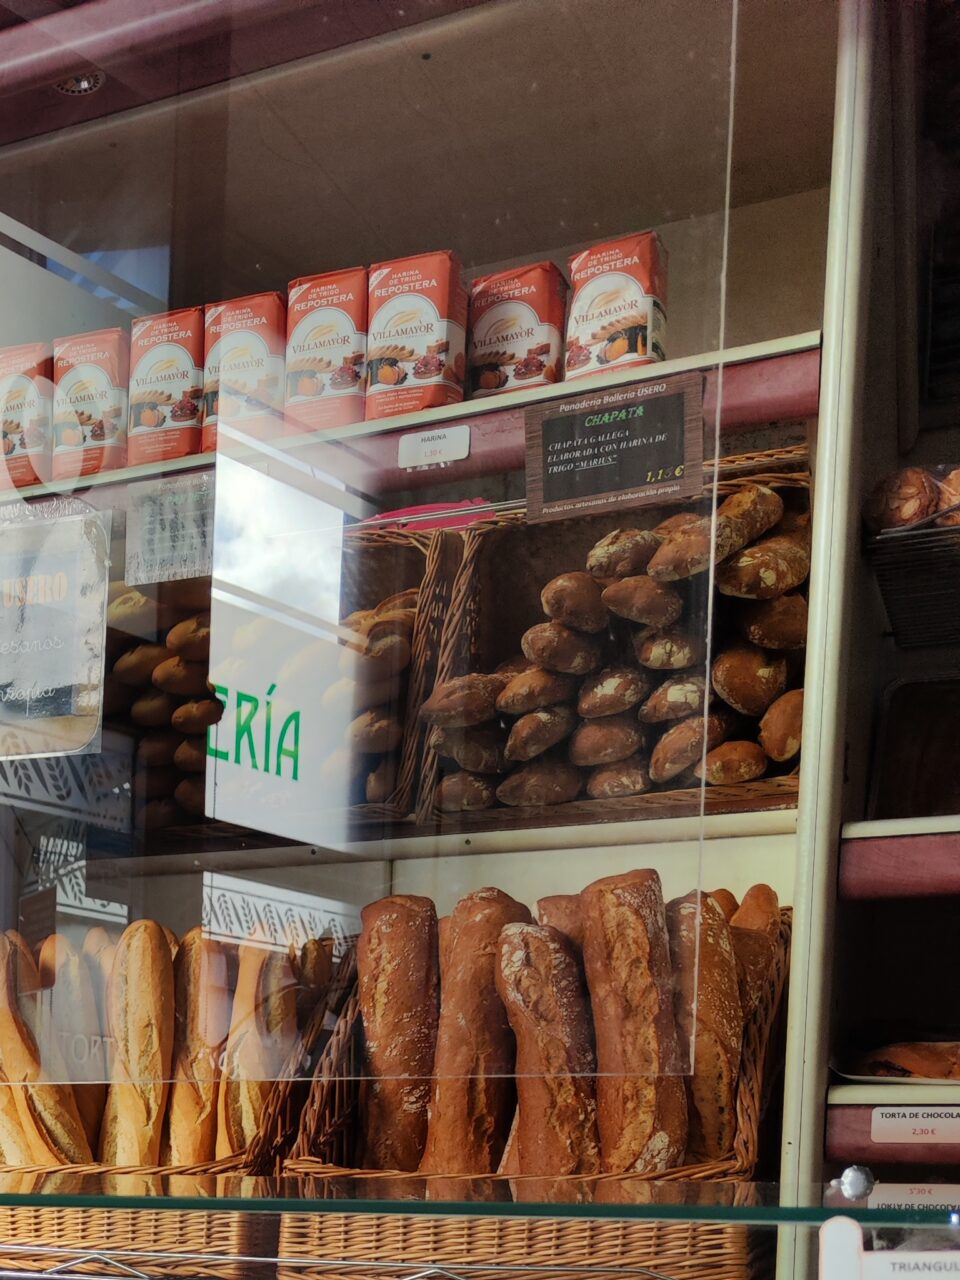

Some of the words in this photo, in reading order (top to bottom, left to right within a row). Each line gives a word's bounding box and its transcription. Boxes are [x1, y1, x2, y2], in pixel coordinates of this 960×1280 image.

[574, 256, 639, 281] REPOSTERA
[374, 279, 437, 298] REPOSTERA
[475, 285, 536, 308] REPOSTERA
[294, 292, 354, 312] REPOSTERA
[210, 316, 268, 334] REPOSTERA
[138, 330, 192, 346] REPOSTERA
[637, 383, 667, 397] USERO
[584, 405, 645, 427] CHAPATA
[421, 433, 447, 443] HARINA
[548, 436, 588, 451] CHAPATA
[590, 429, 629, 443] GALLEGA
[547, 448, 598, 463] ELABORADA
[600, 443, 618, 453] CON
[620, 435, 654, 449] HARINA
[655, 432, 668, 442] DE
[548, 462, 574, 474] TRIGO
[674, 465, 684, 477] €
[542, 504, 574, 514] Productos
[1, 571, 69, 609] USERO
[881, 1111, 906, 1119] TORTA
[909, 1111, 920, 1119] DE
[912, 1128, 929, 1136] 2,30
